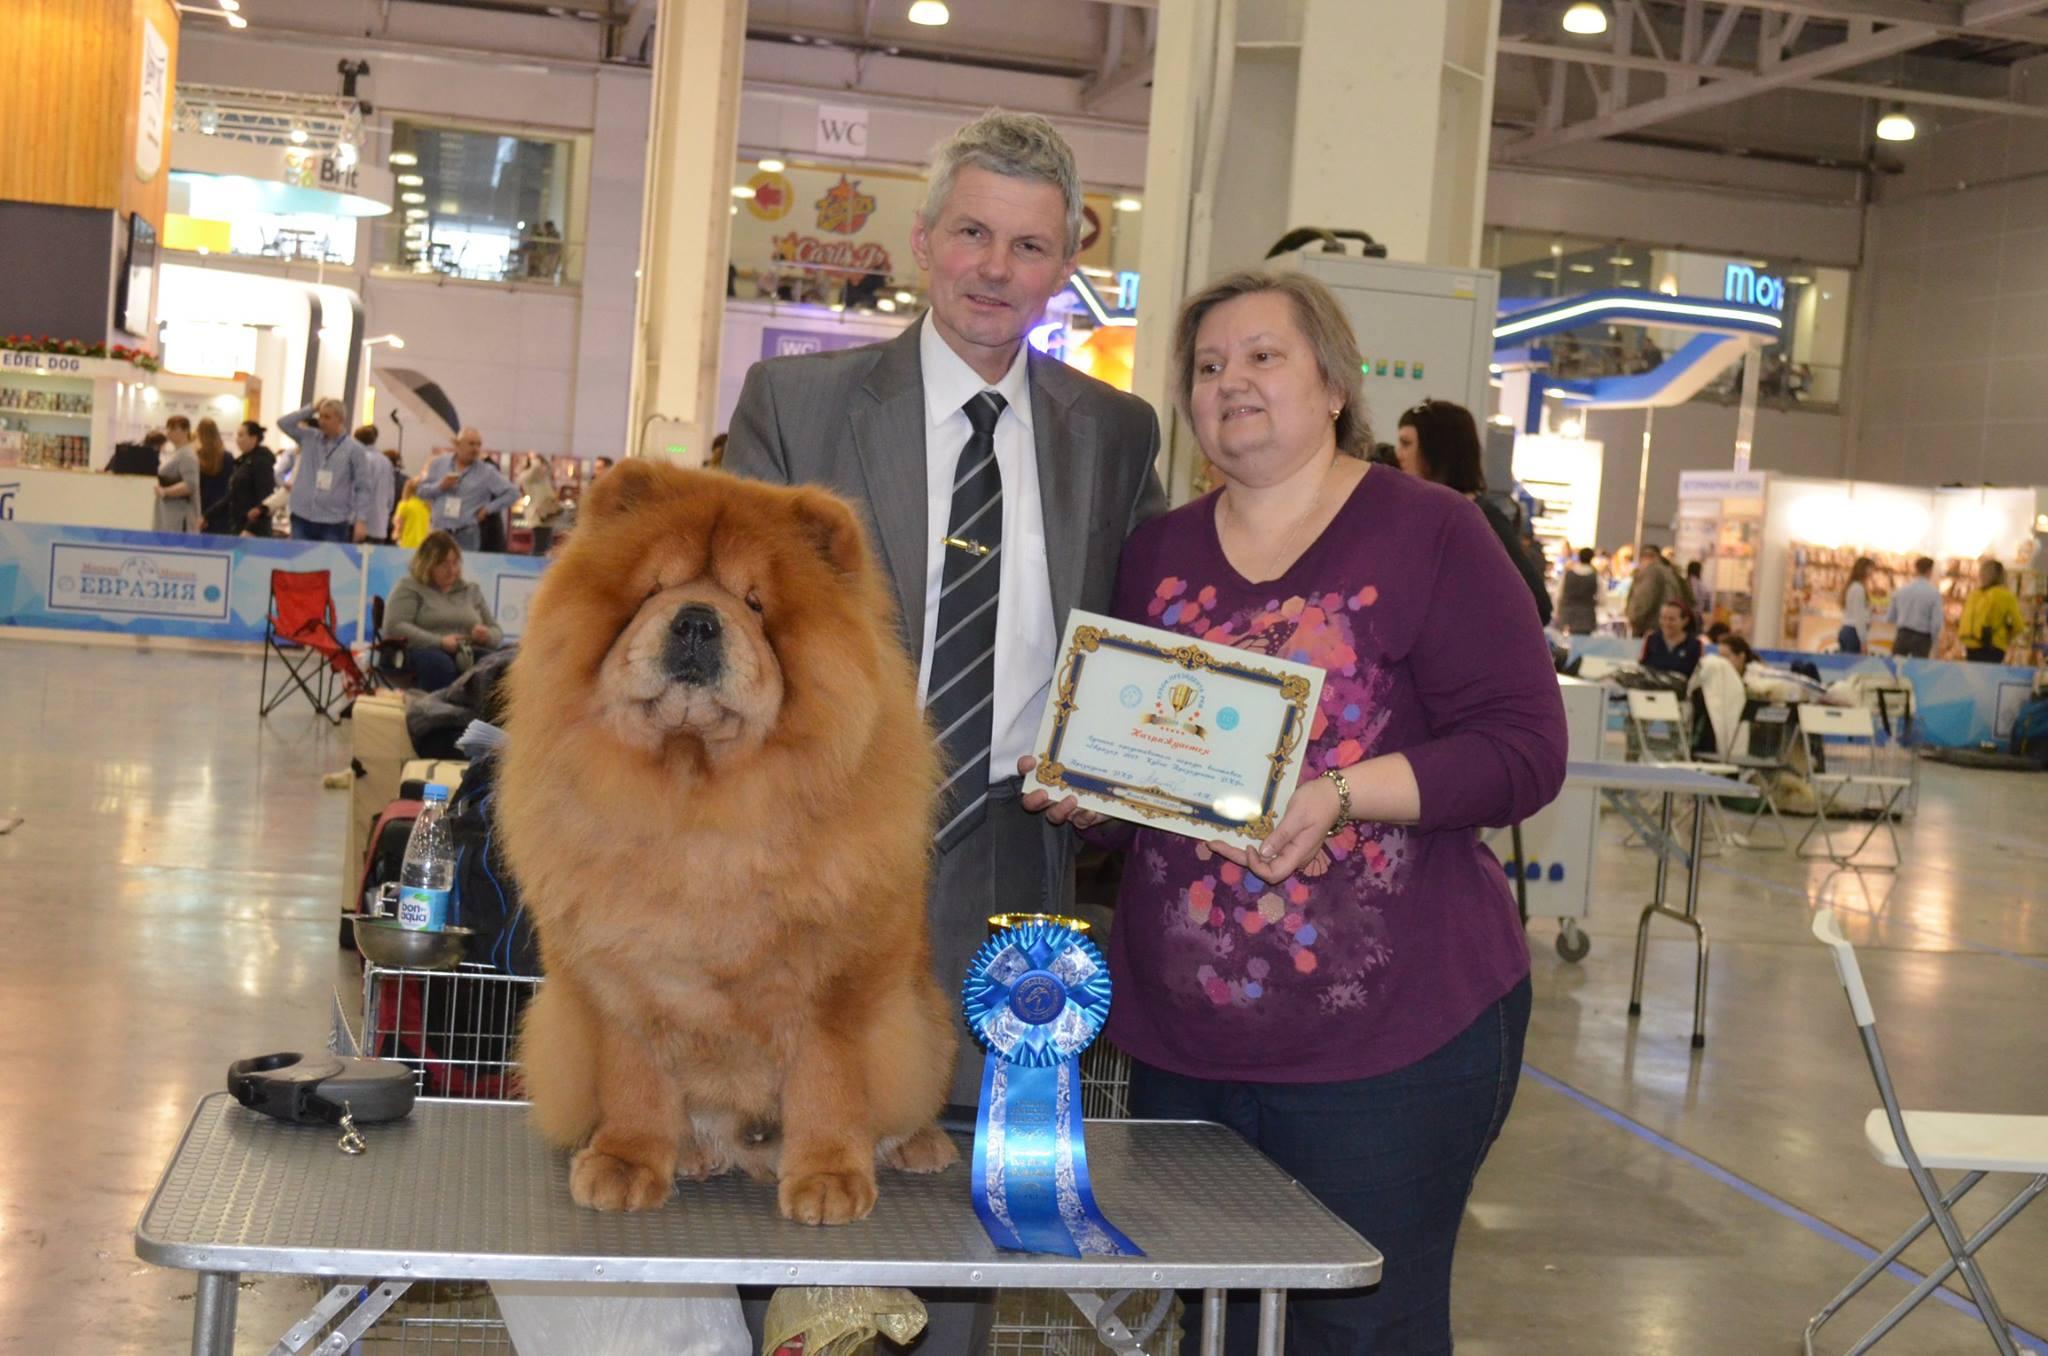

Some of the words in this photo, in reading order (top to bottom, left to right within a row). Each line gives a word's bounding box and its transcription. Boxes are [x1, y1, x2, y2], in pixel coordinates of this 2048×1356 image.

[820, 119, 867, 146] WC
[320, 156, 360, 189] Brit
[782, 341, 815, 356] WC
[3, 352, 43, 368] EDEL
[48, 357, 80, 371] DOG
[80, 576, 196, 601] ЕВРАЗИЯ
[401, 912, 427, 922] aqua
